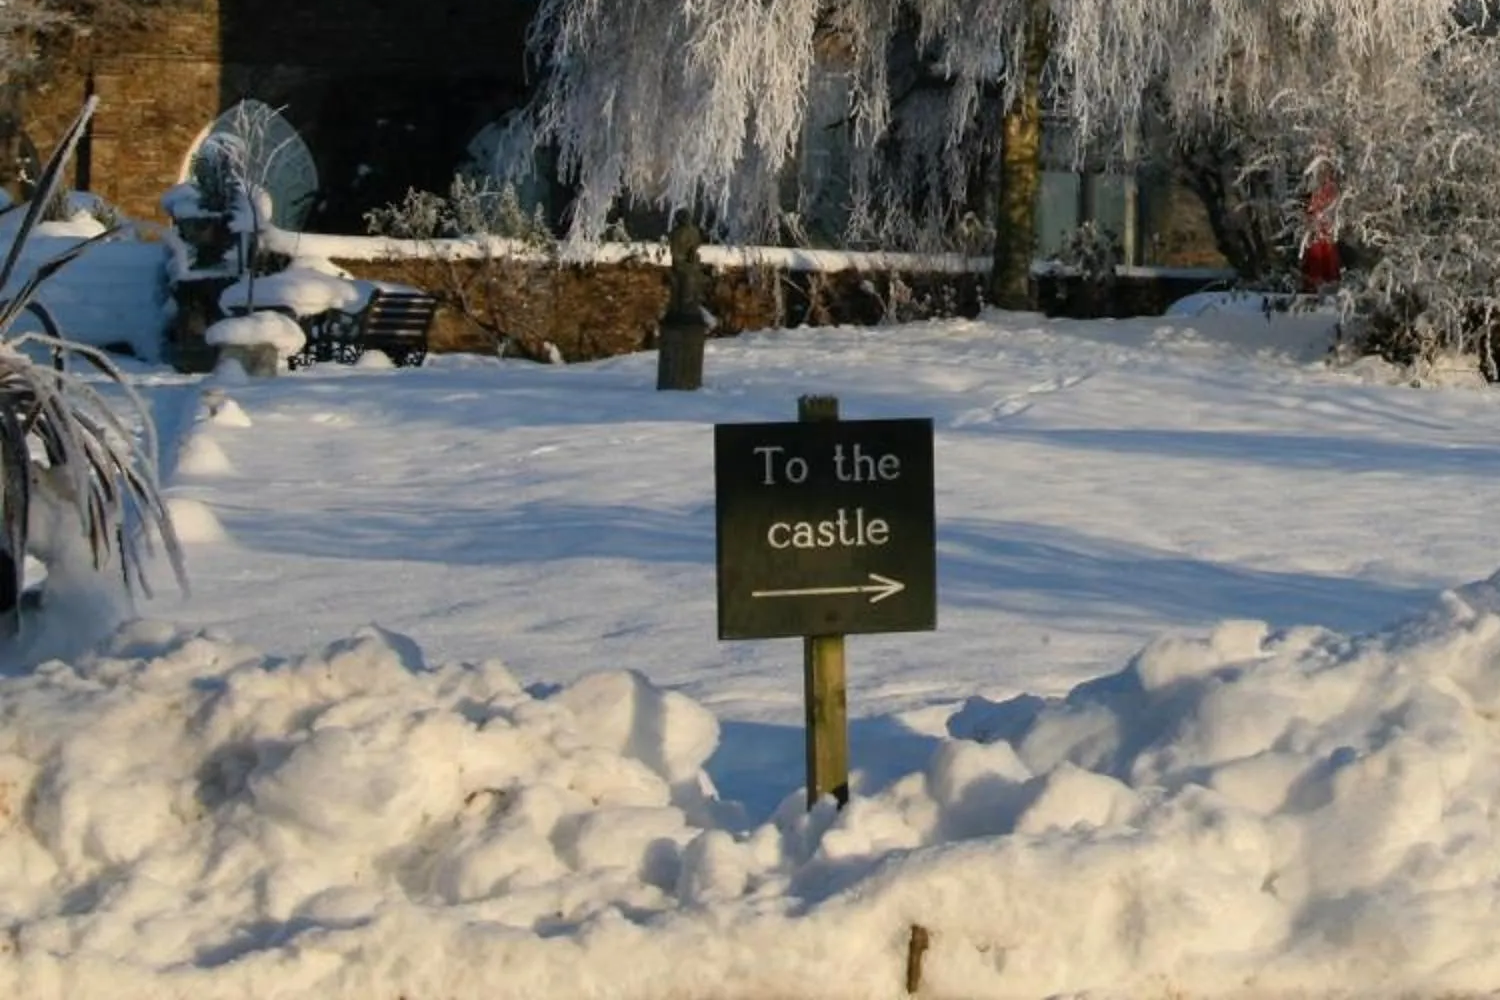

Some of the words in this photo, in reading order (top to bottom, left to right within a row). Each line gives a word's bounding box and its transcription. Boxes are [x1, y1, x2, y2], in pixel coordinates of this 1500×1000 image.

[753, 446, 808, 485] To
[833, 444, 900, 482] the
[767, 508, 890, 548] castle
